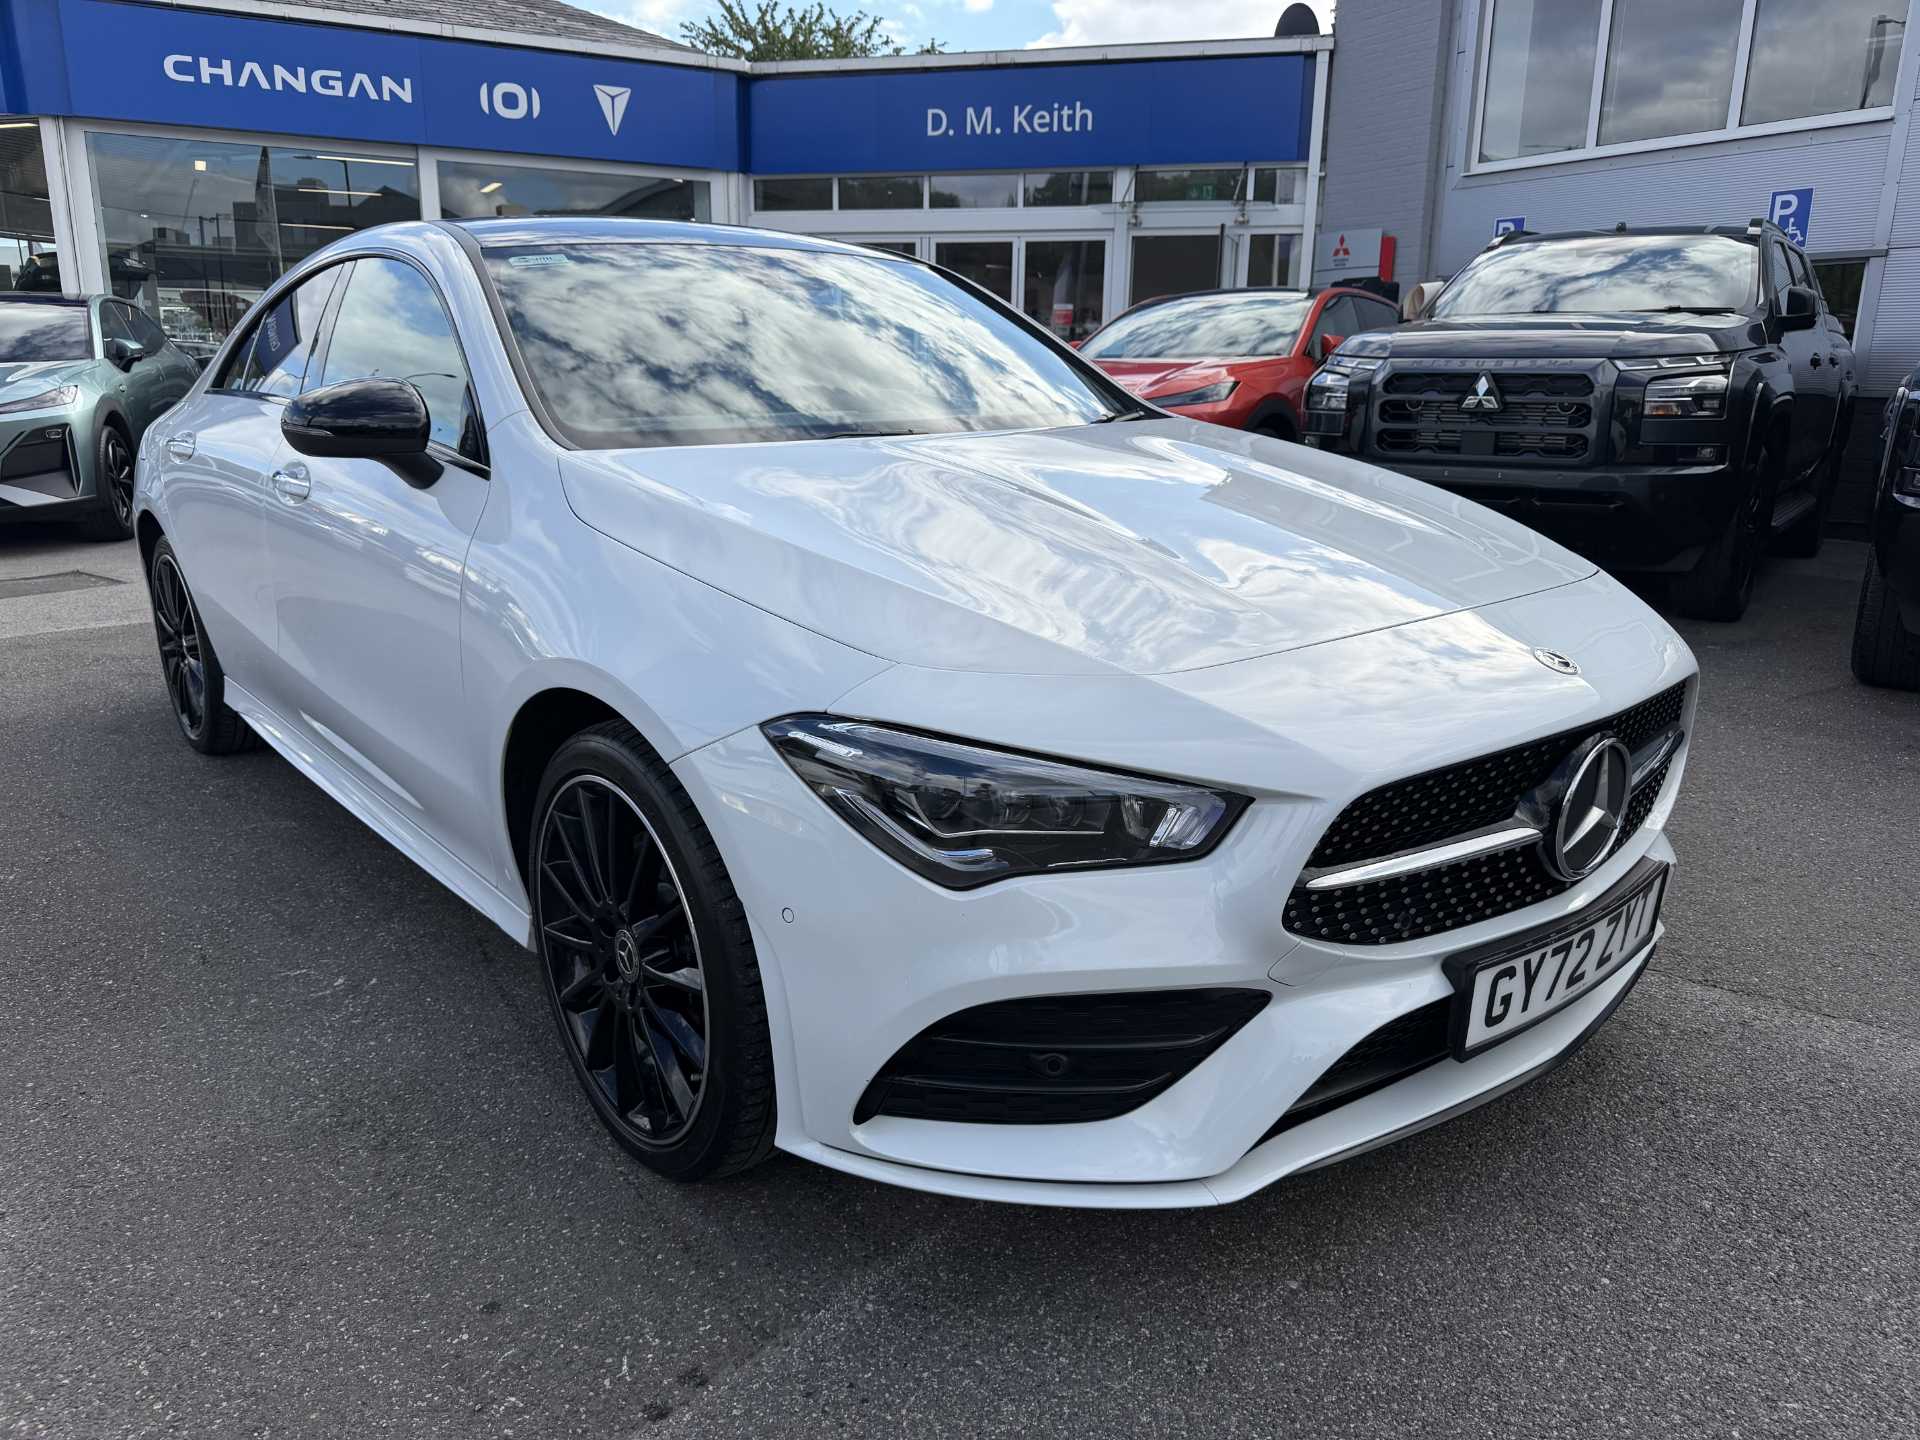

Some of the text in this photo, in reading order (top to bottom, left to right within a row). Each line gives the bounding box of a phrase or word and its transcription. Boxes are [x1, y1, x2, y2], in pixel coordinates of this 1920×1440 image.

[163, 54, 413, 104] CHANGAN
[927, 101, 1093, 136] D. M. Keith
[1773, 194, 1798, 225] P
[1485, 884, 1655, 1028] GY72 ZYT
